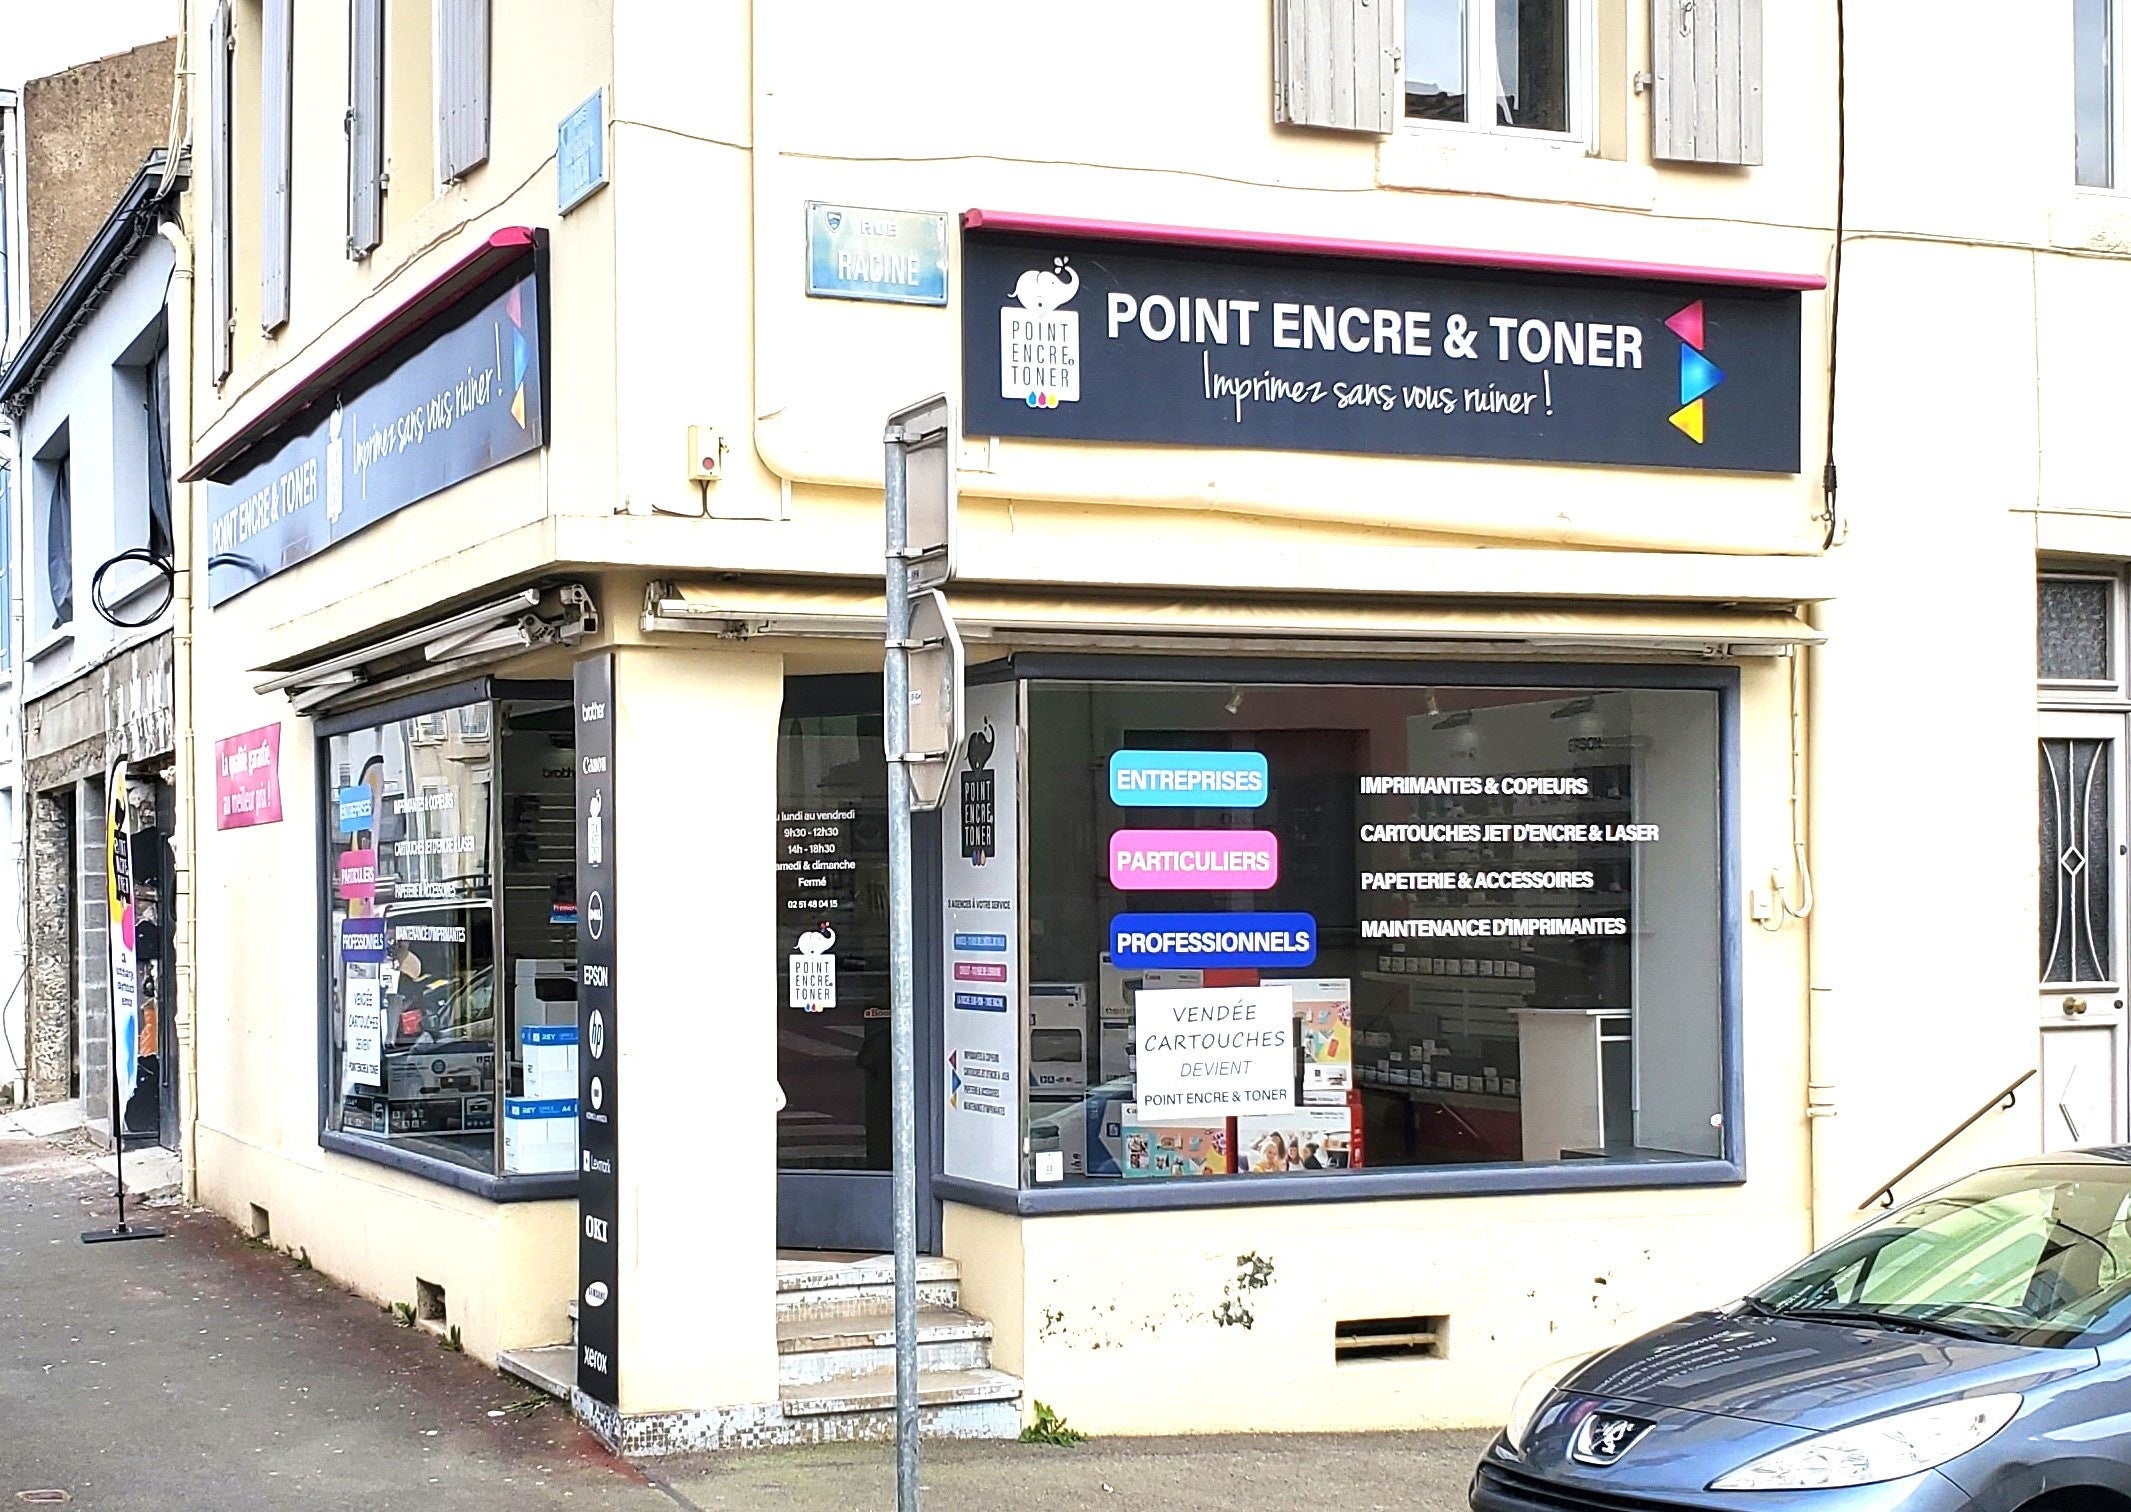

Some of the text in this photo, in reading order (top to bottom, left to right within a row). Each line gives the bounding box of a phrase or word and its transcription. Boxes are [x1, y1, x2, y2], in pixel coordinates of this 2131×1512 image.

[861, 219, 897, 237] RUE
[837, 249, 920, 287] RACINE
[1011, 320, 1069, 343] POINT
[1107, 292, 1644, 369] POINT ENCRE & TONER
[1011, 343, 1070, 366] ENCRE
[1010, 366, 1070, 388] TONER
[1203, 350, 1328, 423] Imprimez
[1333, 380, 1398, 412] sans
[1403, 384, 1458, 414] vous
[1464, 380, 1537, 416] ruiner
[353, 411, 397, 500] Imprimez
[397, 406, 425, 454] sans
[426, 390, 453, 434] vous
[455, 366, 494, 419] ruiner
[211, 506, 239, 557] POINT
[239, 486, 270, 544] ENCRE
[270, 481, 280, 524] &
[280, 456, 318, 518] TONER
[581, 701, 605, 723] brother
[542, 766, 576, 779] broth
[582, 755, 607, 775] Canon
[964, 780, 992, 802] POINT
[1116, 769, 1263, 792] ENTREPRISES
[1360, 776, 1589, 795] IMPRIMANTES & COPIEURS
[781, 810, 803, 821] lundi
[804, 813, 815, 821] au
[816, 809, 856, 821] vendredi
[964, 803, 993, 825] ENCRE
[783, 828, 807, 838] 9h30
[812, 826, 839, 837] 12h30
[964, 825, 992, 847] TONER
[1360, 823, 1659, 842] CARTOUCHES JET D'ENCRE & LASER
[788, 843, 803, 854] 14h
[809, 843, 836, 854] 18h30
[776, 859, 856, 871] amedi & dimanche
[1116, 850, 1270, 872] PARTICULIERS
[797, 876, 827, 888] Fermé
[1361, 871, 1594, 890] PAPETERIE & ACCESSOIRES
[1361, 917, 1627, 938] MAINTENANCE D'IMPRIMANTES
[1116, 931, 1310, 954] PROFESSIONNELS
[583, 964, 609, 988] EPSON
[795, 961, 829, 974] POINT
[795, 974, 830, 987] ENCRE
[795, 988, 830, 1001] TONER
[1173, 998, 1257, 1023] VENDÉE
[1144, 1030, 1286, 1052] CARTOUCHES
[1180, 1060, 1253, 1078] DEVIENT
[1144, 1093, 1184, 1106] POINT
[1186, 1091, 1229, 1104] ENCRE
[1232, 1090, 1242, 1102] &
[1244, 1088, 1288, 1102] TONER
[590, 1154, 612, 1175] Lexmark
[585, 1214, 609, 1244] OKI
[583, 1344, 608, 1376] xerox
